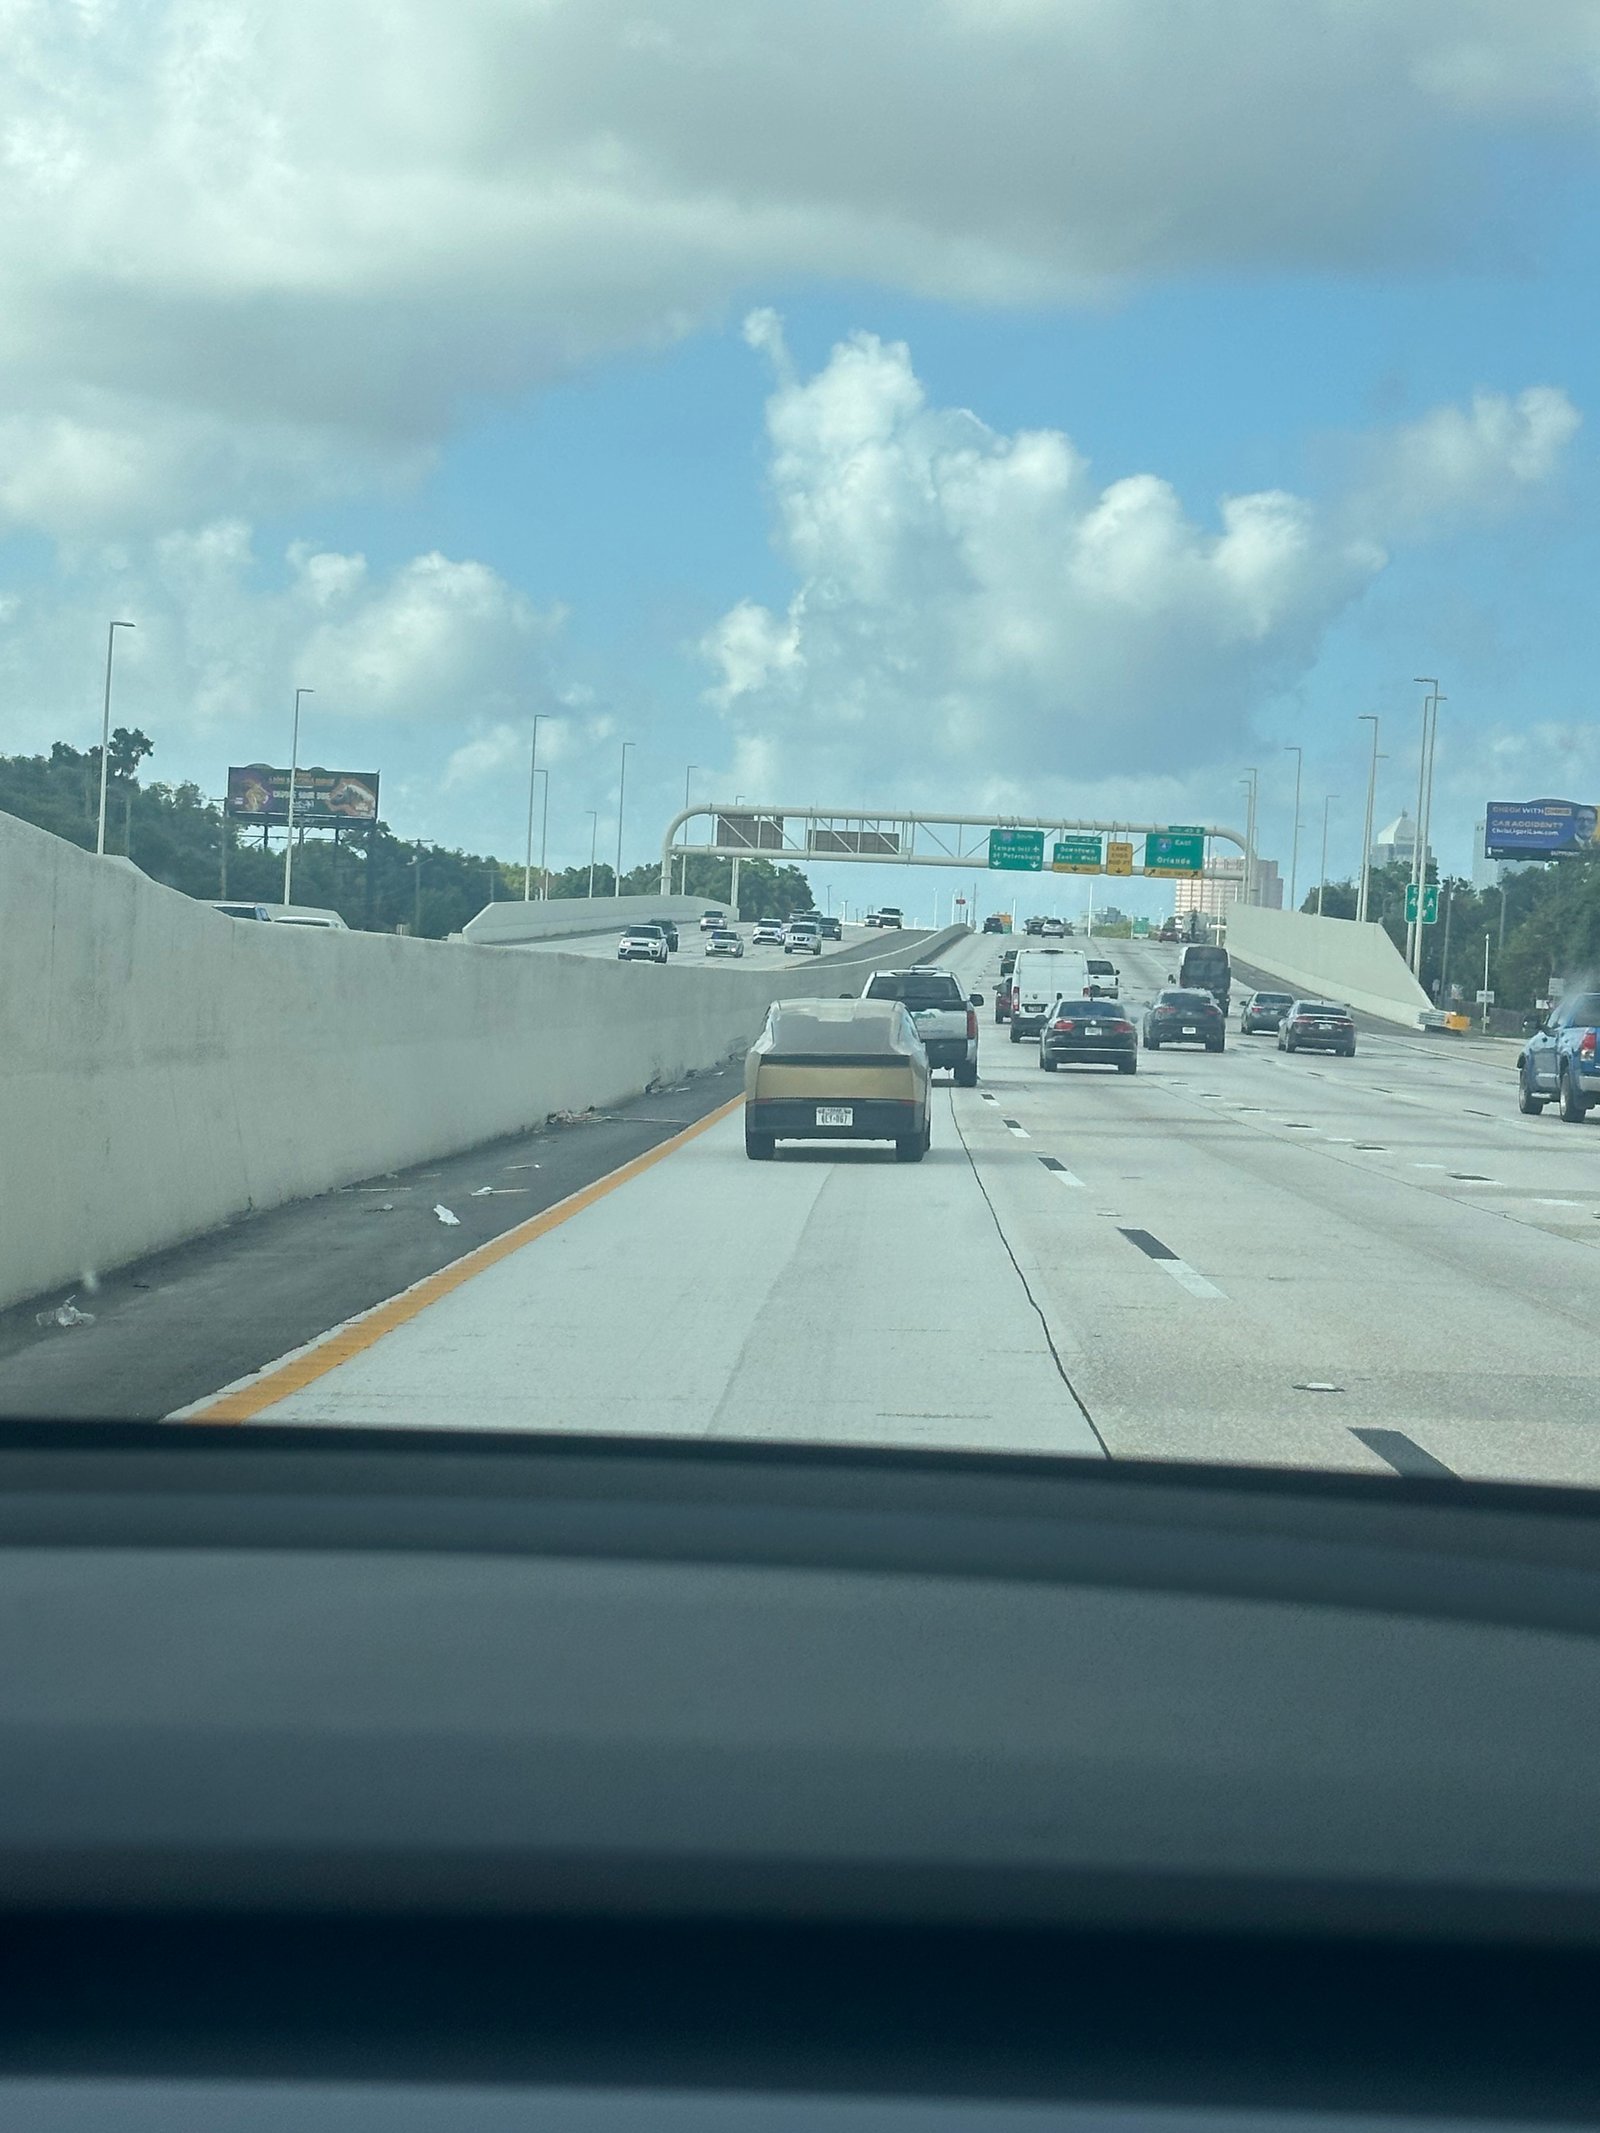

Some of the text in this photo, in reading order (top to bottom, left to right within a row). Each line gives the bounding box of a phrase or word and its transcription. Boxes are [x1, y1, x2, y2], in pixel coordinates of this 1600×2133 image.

[1059, 846, 1095, 854] Downtown
[1003, 852, 1041, 862] Petersburg
[1156, 856, 1191, 865] Orlando
